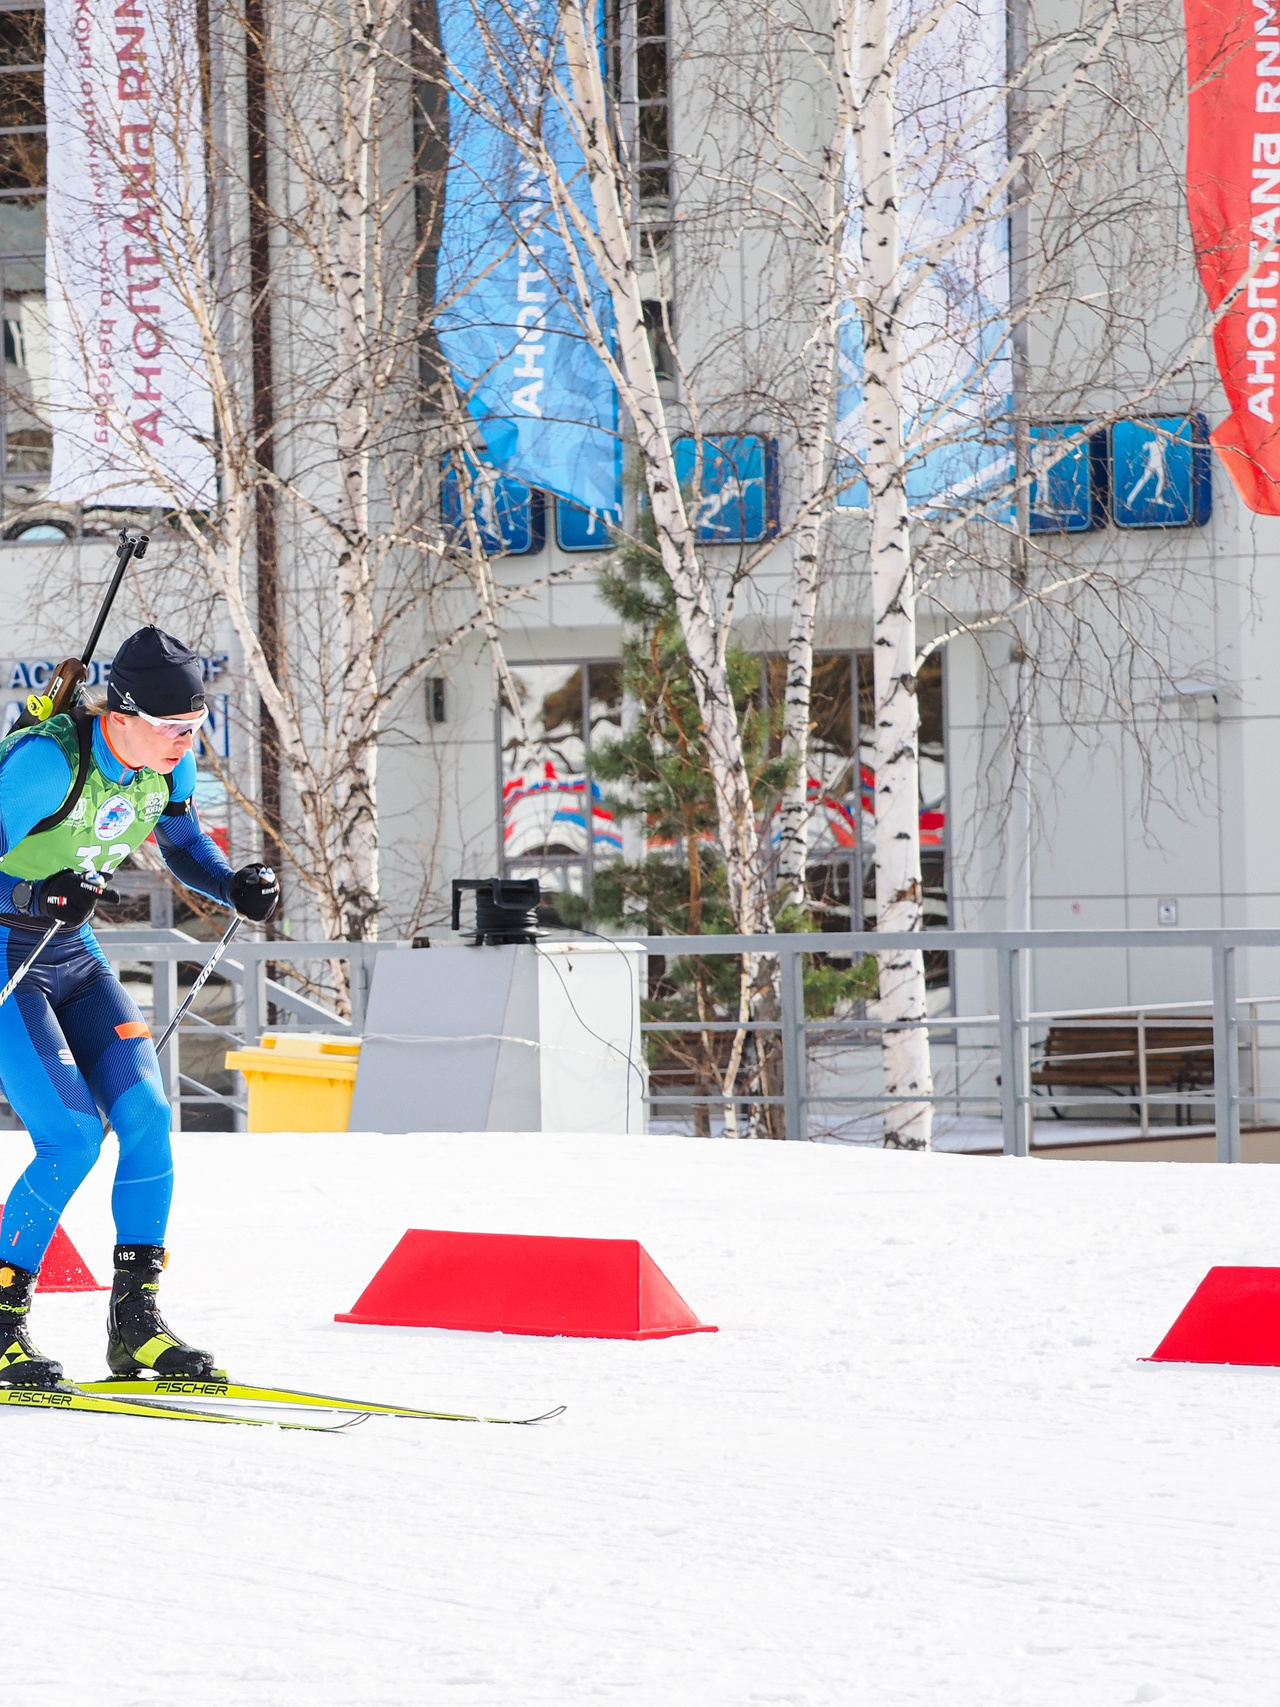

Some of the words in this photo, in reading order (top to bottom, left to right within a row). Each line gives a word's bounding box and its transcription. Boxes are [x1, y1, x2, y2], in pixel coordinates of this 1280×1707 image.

[75, 843, 132, 875] 32
[117, 1251, 136, 1262] 182
[155, 1381, 229, 1396] FISCHER
[7, 1390, 73, 1406] FISCHER
